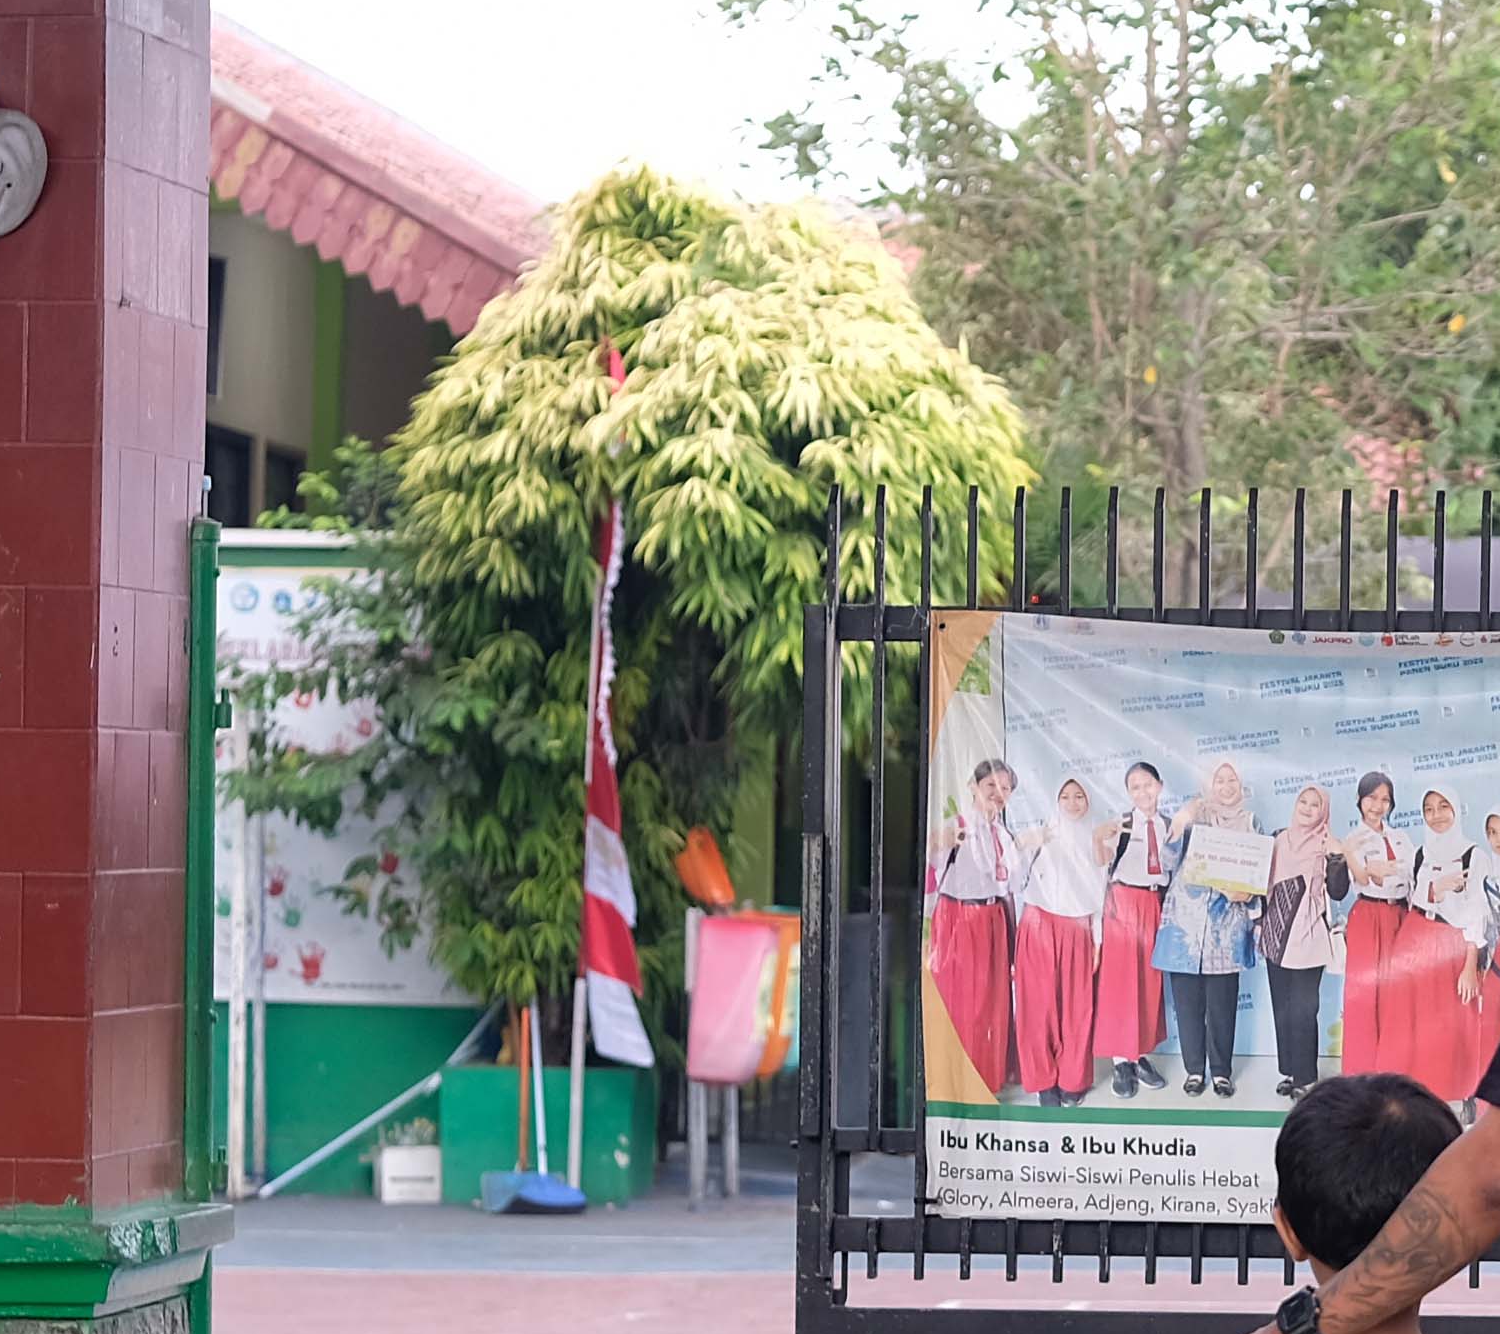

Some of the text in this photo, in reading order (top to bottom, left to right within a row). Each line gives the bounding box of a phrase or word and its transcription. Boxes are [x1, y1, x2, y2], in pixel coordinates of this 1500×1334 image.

[939, 1130, 1197, 1158] Ibu Khansa & Ibu Khudia
[939, 1161, 1260, 1188] Bersama Siswi-Siswi Penulis Hebat
[936, 1185, 993, 1211] (Glory,
[999, 1190, 1078, 1212] Almeera,
[1084, 1194, 1155, 1216] Adjeng,
[1161, 1196, 1220, 1217] Kirana,
